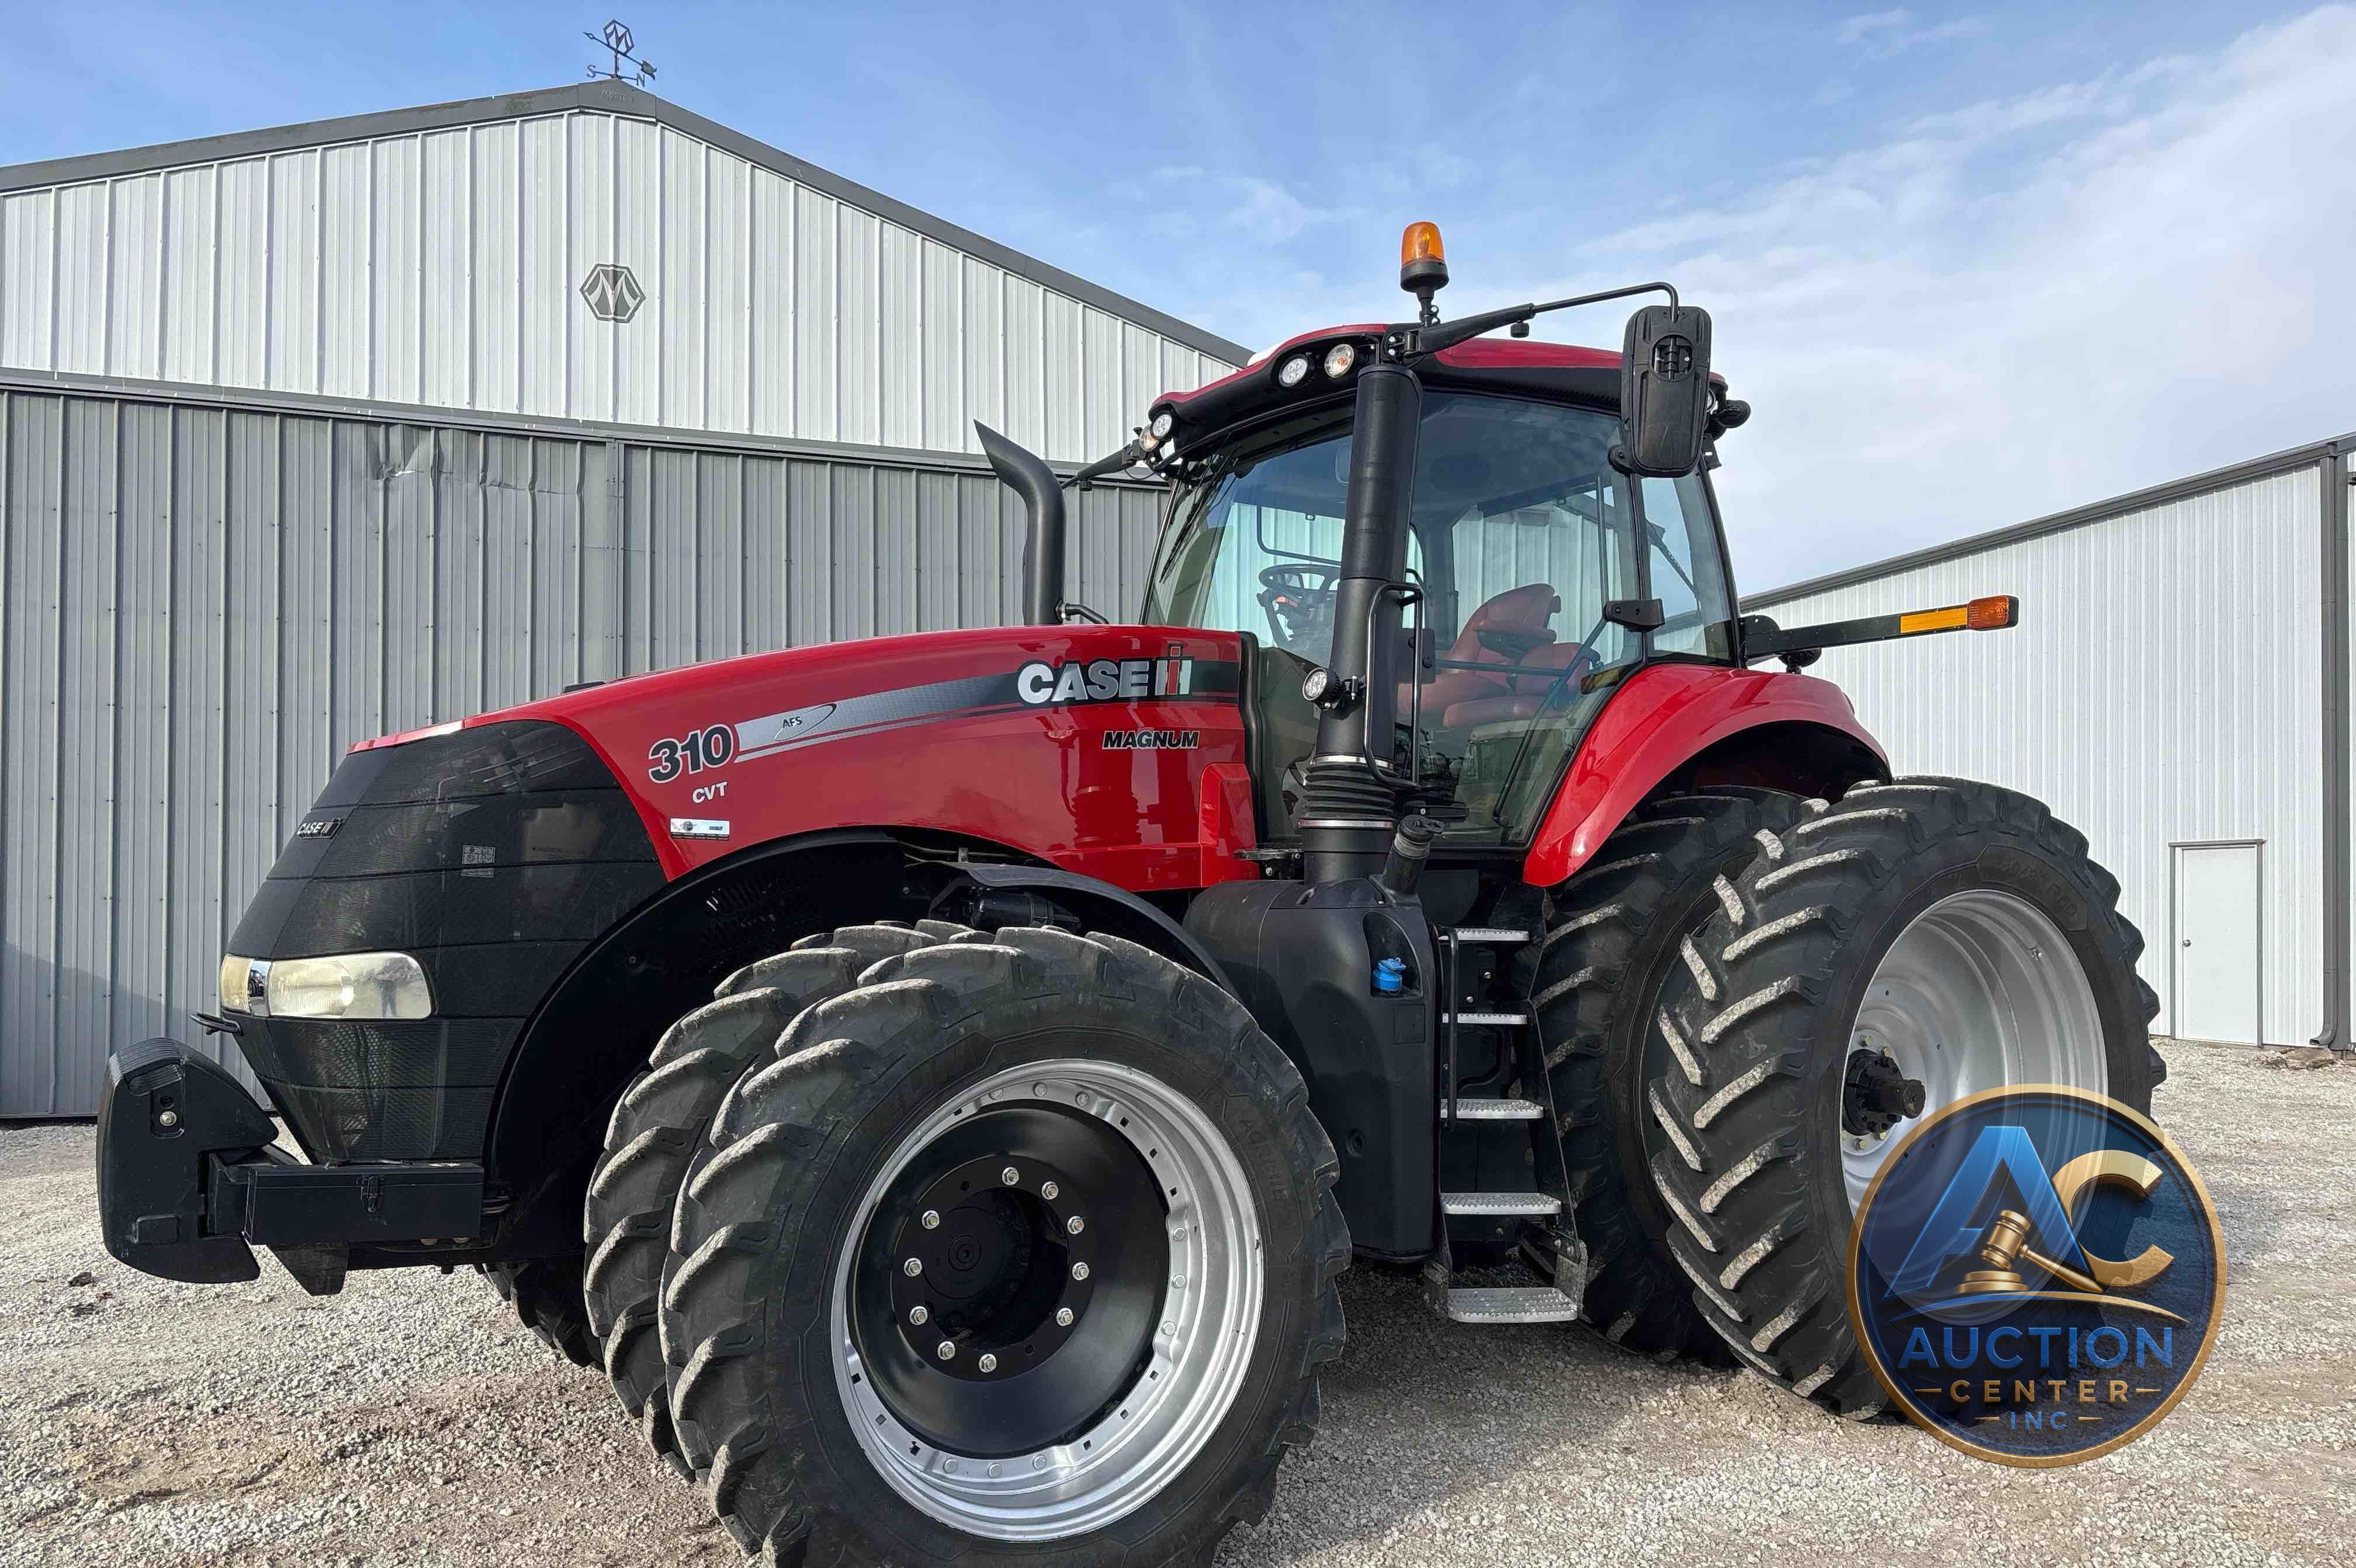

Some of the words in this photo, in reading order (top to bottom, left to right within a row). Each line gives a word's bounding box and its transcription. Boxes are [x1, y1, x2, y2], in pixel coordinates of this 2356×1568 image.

[587, 64, 596, 78] S
[636, 73, 645, 87] N
[1017, 659, 1150, 705] CASE
[782, 716, 803, 729] AFS
[1102, 730, 1200, 750] MAGNUM
[648, 723, 734, 784] 310
[692, 781, 728, 804] CVT
[296, 822, 324, 835] CASE
